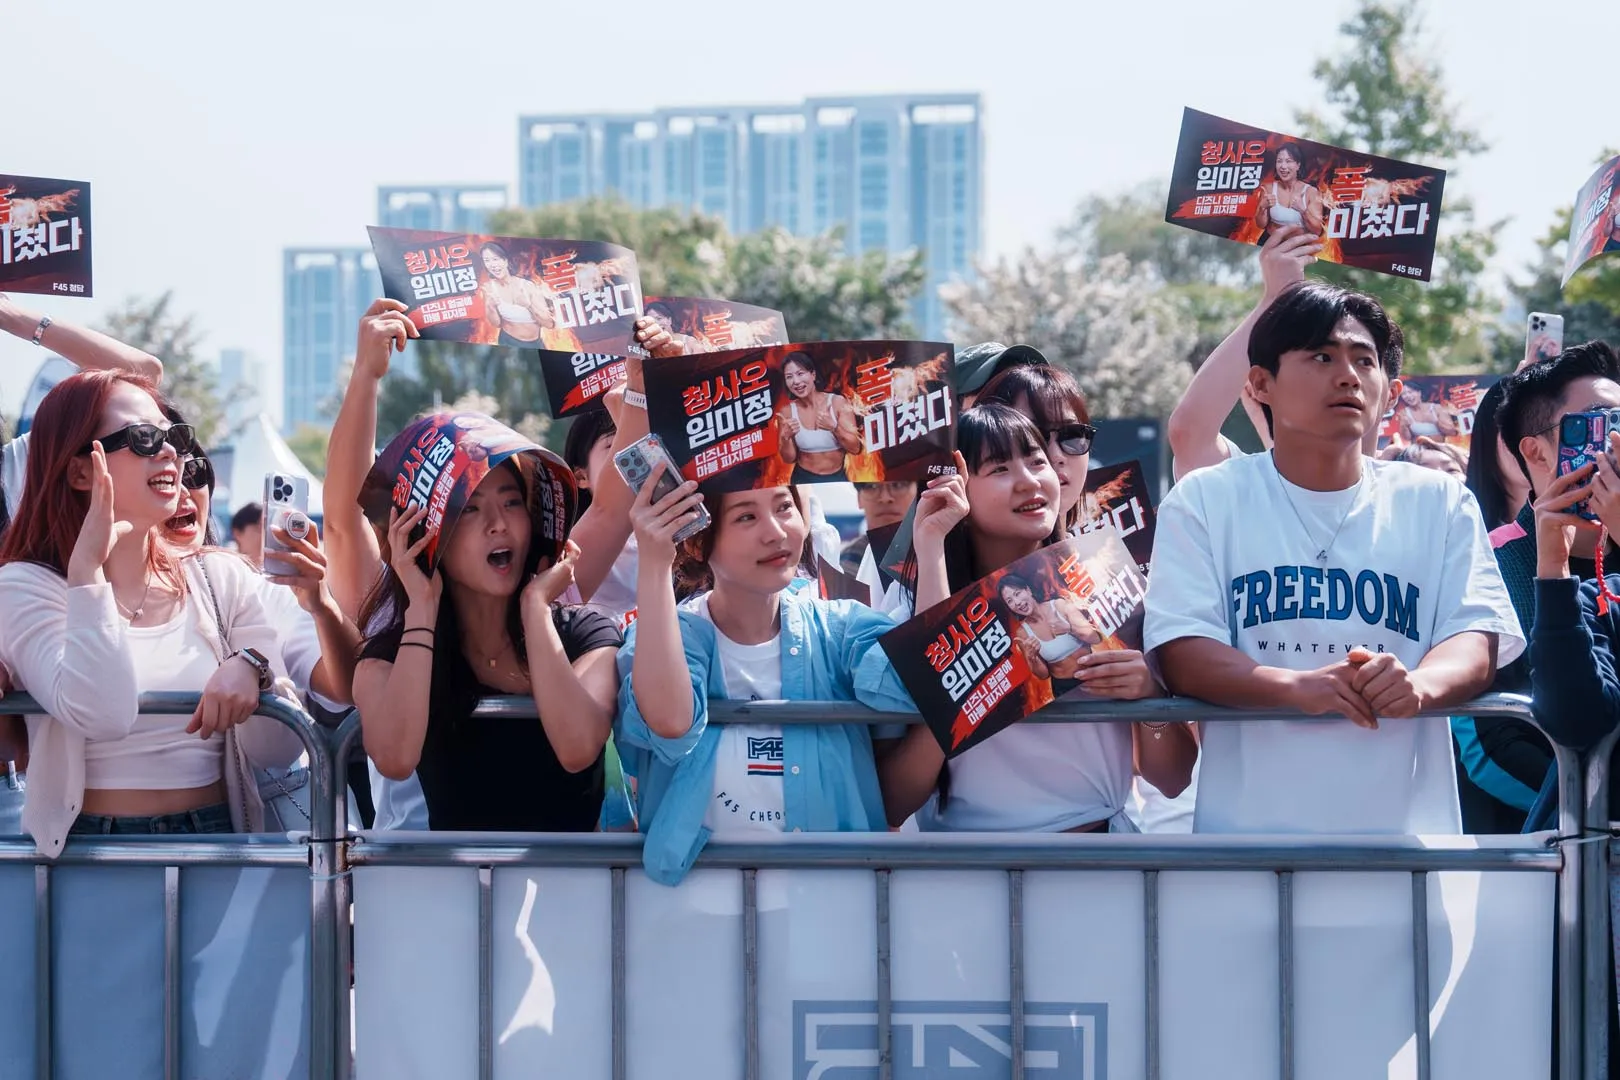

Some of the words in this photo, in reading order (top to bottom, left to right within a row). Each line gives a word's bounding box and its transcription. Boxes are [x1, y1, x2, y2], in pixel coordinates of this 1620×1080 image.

[1201, 140, 1266, 165] 청사오
[1196, 166, 1263, 191] 임미정
[1331, 166, 1369, 203] 폼
[1194, 205, 1212, 215] 마블
[1212, 204, 1238, 214] 피지컬
[1196, 195, 1222, 205] 디즈니
[1222, 194, 1248, 205] 얼굴에
[1327, 202, 1430, 239] 미쳤다
[403, 244, 473, 275] 청사오
[541, 252, 576, 294] 폼
[1391, 263, 1406, 273] F45
[1407, 266, 1423, 276] 청담
[53, 282, 68, 292] F45
[410, 267, 478, 300] 임미정
[420, 302, 447, 314] 디즈니
[448, 296, 473, 309] 얼굴에
[553, 283, 642, 329] 미쳤다
[580, 369, 608, 390] 디즈니
[582, 382, 601, 399] 마블
[681, 360, 770, 417] 청사오
[855, 356, 894, 407] 폼
[686, 389, 773, 450] 임미정
[863, 385, 952, 454] 미쳤다
[695, 443, 728, 466] 디즈니
[730, 429, 763, 452] 얼굴에
[696, 459, 719, 478] 마블
[720, 446, 754, 469] 피지컬
[392, 427, 444, 509] 청사오
[927, 465, 942, 475] F45
[1057, 553, 1098, 600] 폼
[1088, 563, 1147, 639] 미쳤다
[1232, 565, 1420, 643] FREEDOM
[925, 596, 998, 673] 청사오
[941, 619, 1012, 703] 임미정
[961, 684, 989, 715] 디즈니
[986, 659, 1014, 690] 얼굴에
[967, 702, 988, 726] 마블
[985, 676, 1012, 708] 피지컬
[716, 791, 740, 813] F45
